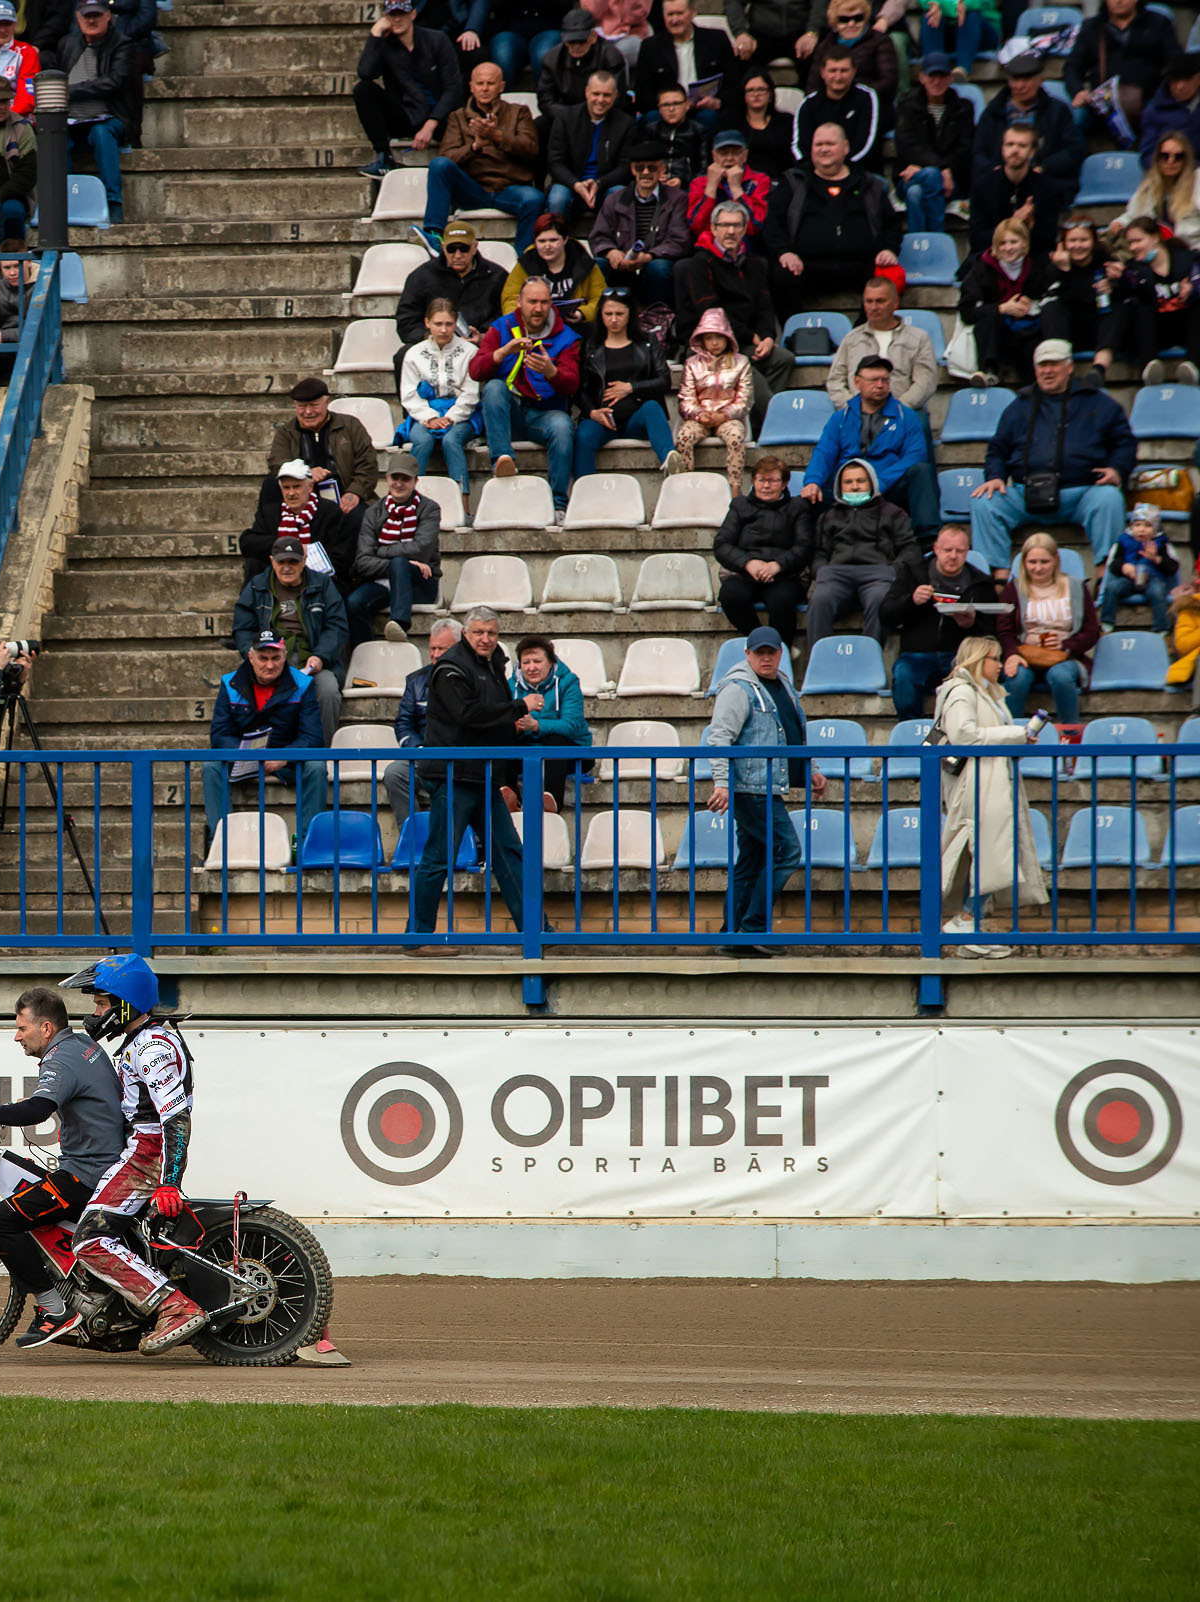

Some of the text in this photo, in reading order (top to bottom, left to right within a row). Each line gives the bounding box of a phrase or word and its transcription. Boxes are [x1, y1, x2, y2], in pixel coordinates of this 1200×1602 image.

[360, 4, 375, 22] 12
[329, 77, 345, 93] 11
[315, 150, 334, 166] 10
[290, 223, 300, 240] 9
[284, 300, 294, 316] 8
[265, 376, 274, 393] 7
[792, 398, 805, 410] 41
[227, 536, 238, 552] 5
[1026, 597, 1073, 624] LOVE
[204, 616, 215, 634] 4
[837, 643, 853, 656] 40
[1120, 637, 1136, 650] 37
[194, 701, 205, 718] 3
[820, 725, 835, 738] 40
[914, 724, 931, 737] 39
[1110, 723, 1127, 736] 37
[167, 785, 178, 803] 2
[711, 817, 724, 830] 41
[903, 816, 919, 829] 39
[1096, 815, 1114, 828] 37
[490, 1074, 829, 1147] OPTIBET
[491, 1152, 829, 1172] SPORTA BĀRS
